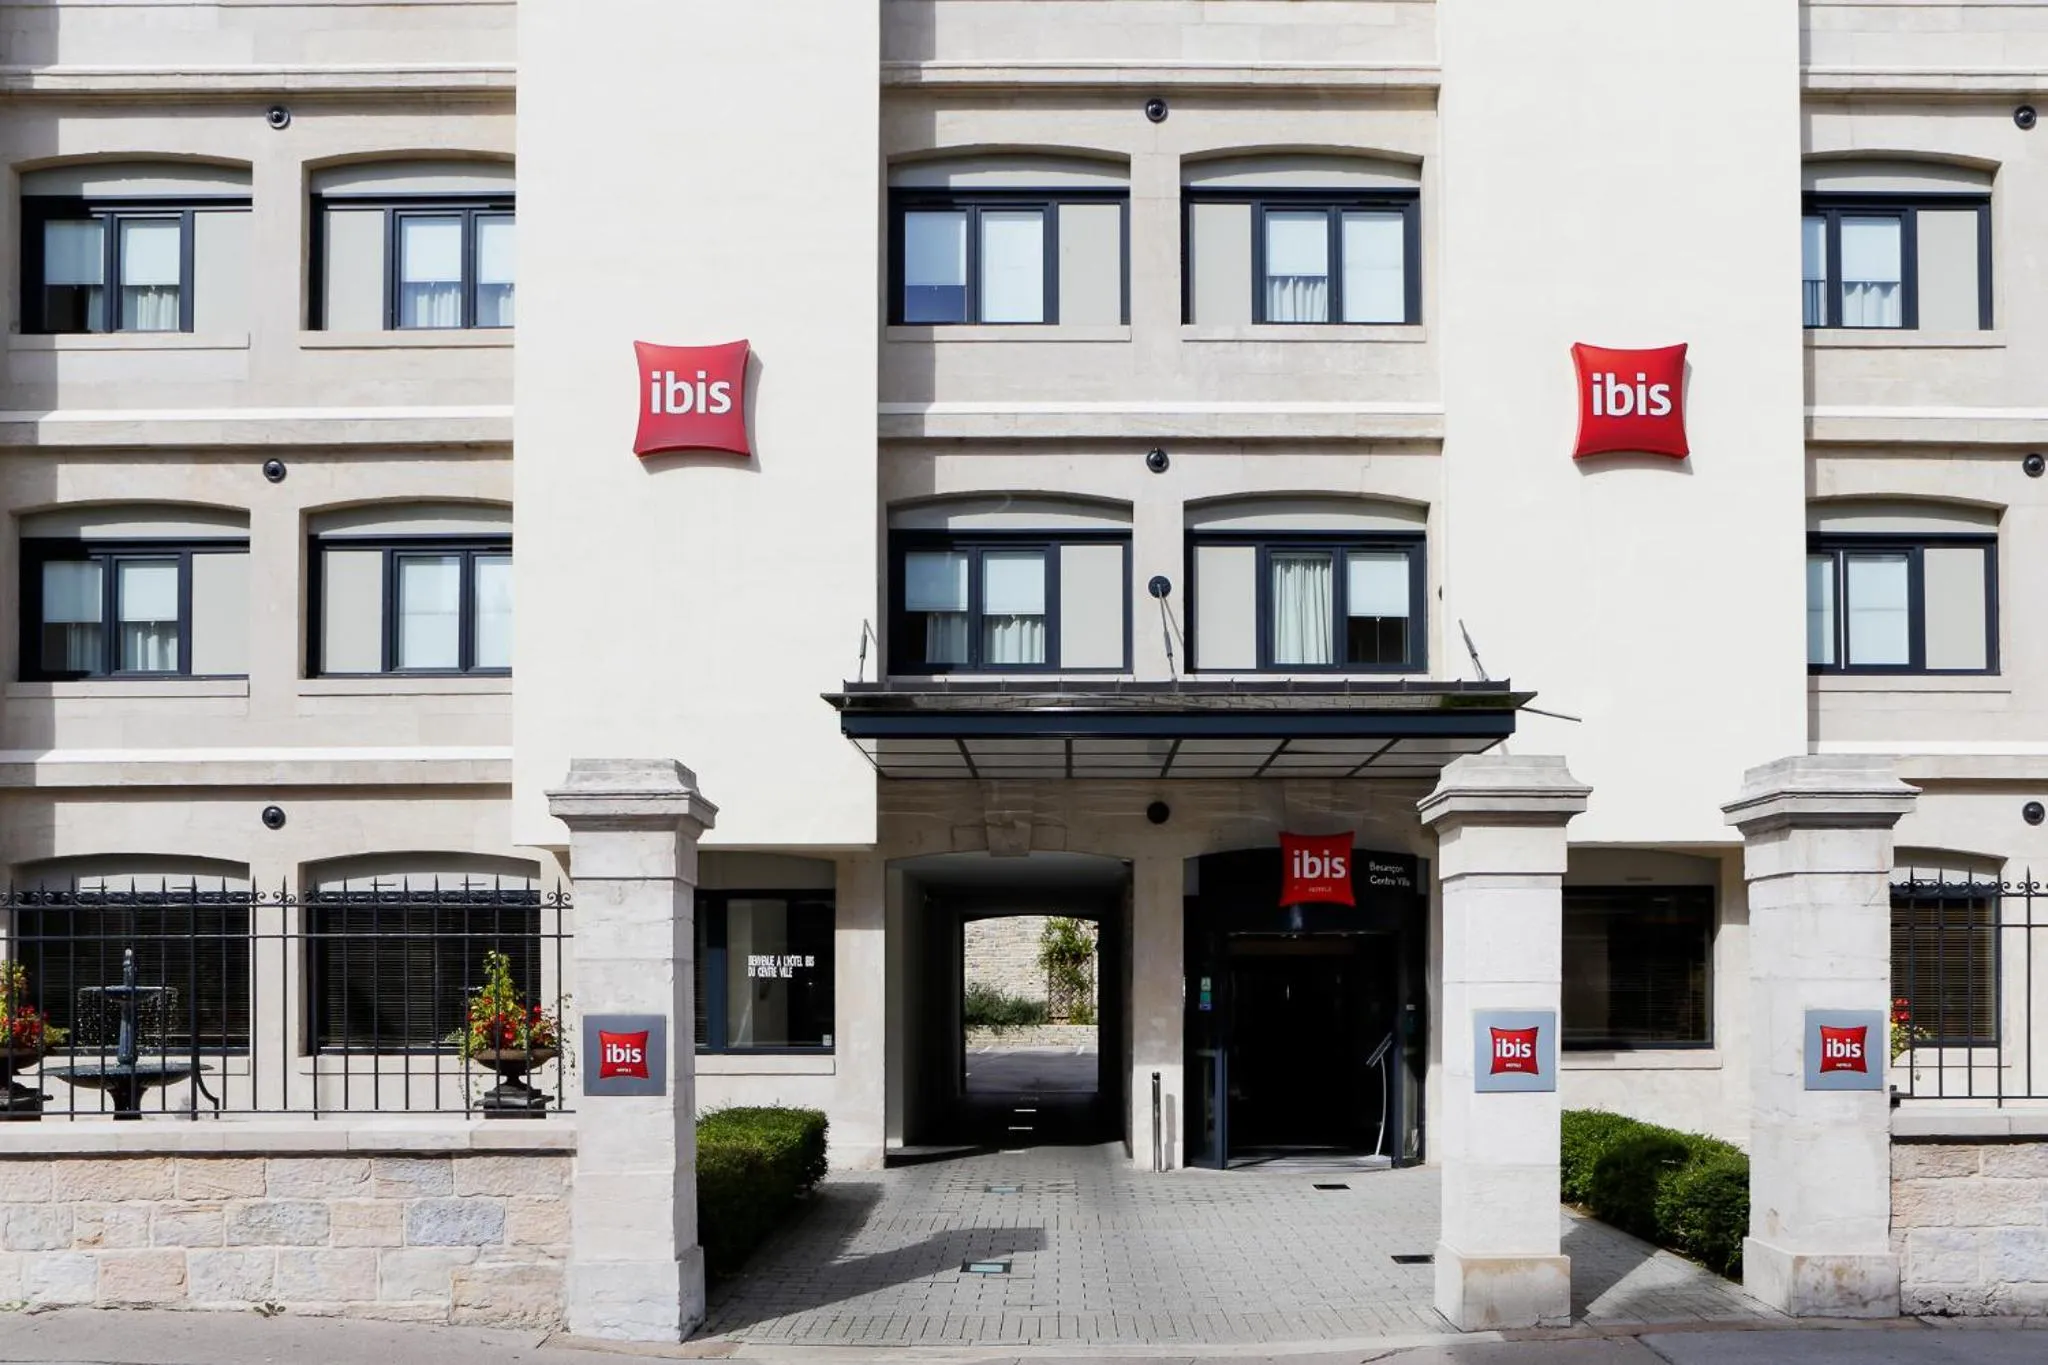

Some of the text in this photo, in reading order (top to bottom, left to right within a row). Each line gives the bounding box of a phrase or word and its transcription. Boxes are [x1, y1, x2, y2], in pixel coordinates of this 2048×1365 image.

[651, 370, 732, 415] ibis
[1592, 372, 1672, 417] ibis
[1293, 849, 1346, 879] ibis
[748, 966, 756, 977] DU
[606, 1043, 642, 1063] ibis
[1496, 1038, 1532, 1058] ibis
[1826, 1038, 1862, 1058] ibis
